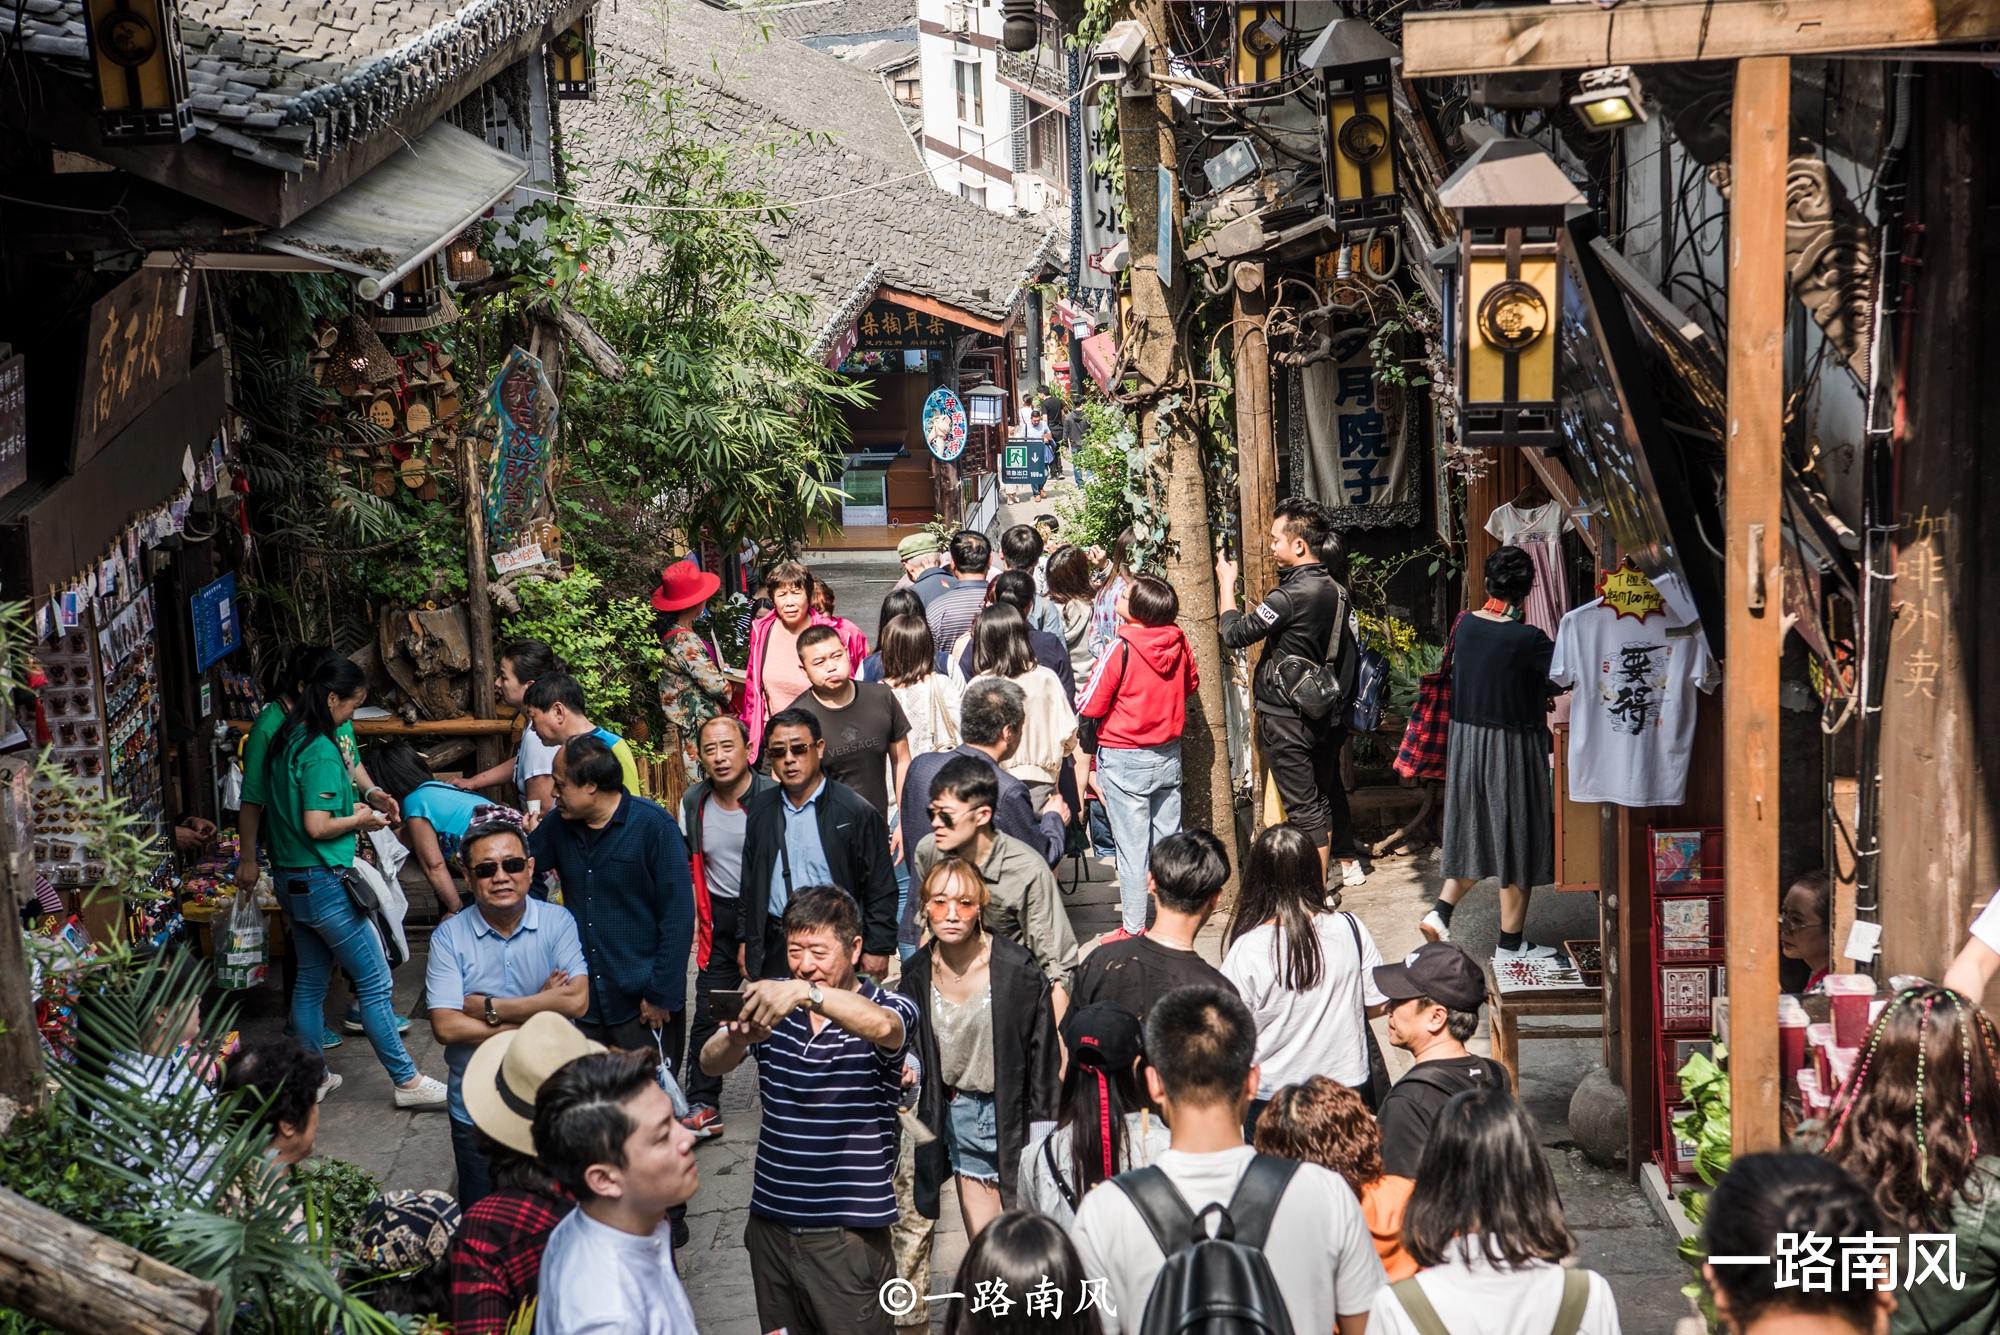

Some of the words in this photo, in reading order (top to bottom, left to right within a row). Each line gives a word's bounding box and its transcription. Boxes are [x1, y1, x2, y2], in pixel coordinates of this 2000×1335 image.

[1896, 505, 1950, 700] 咖啡外卖
[1608, 645, 1669, 736] 要得
[828, 737, 880, 758] VERSACE
